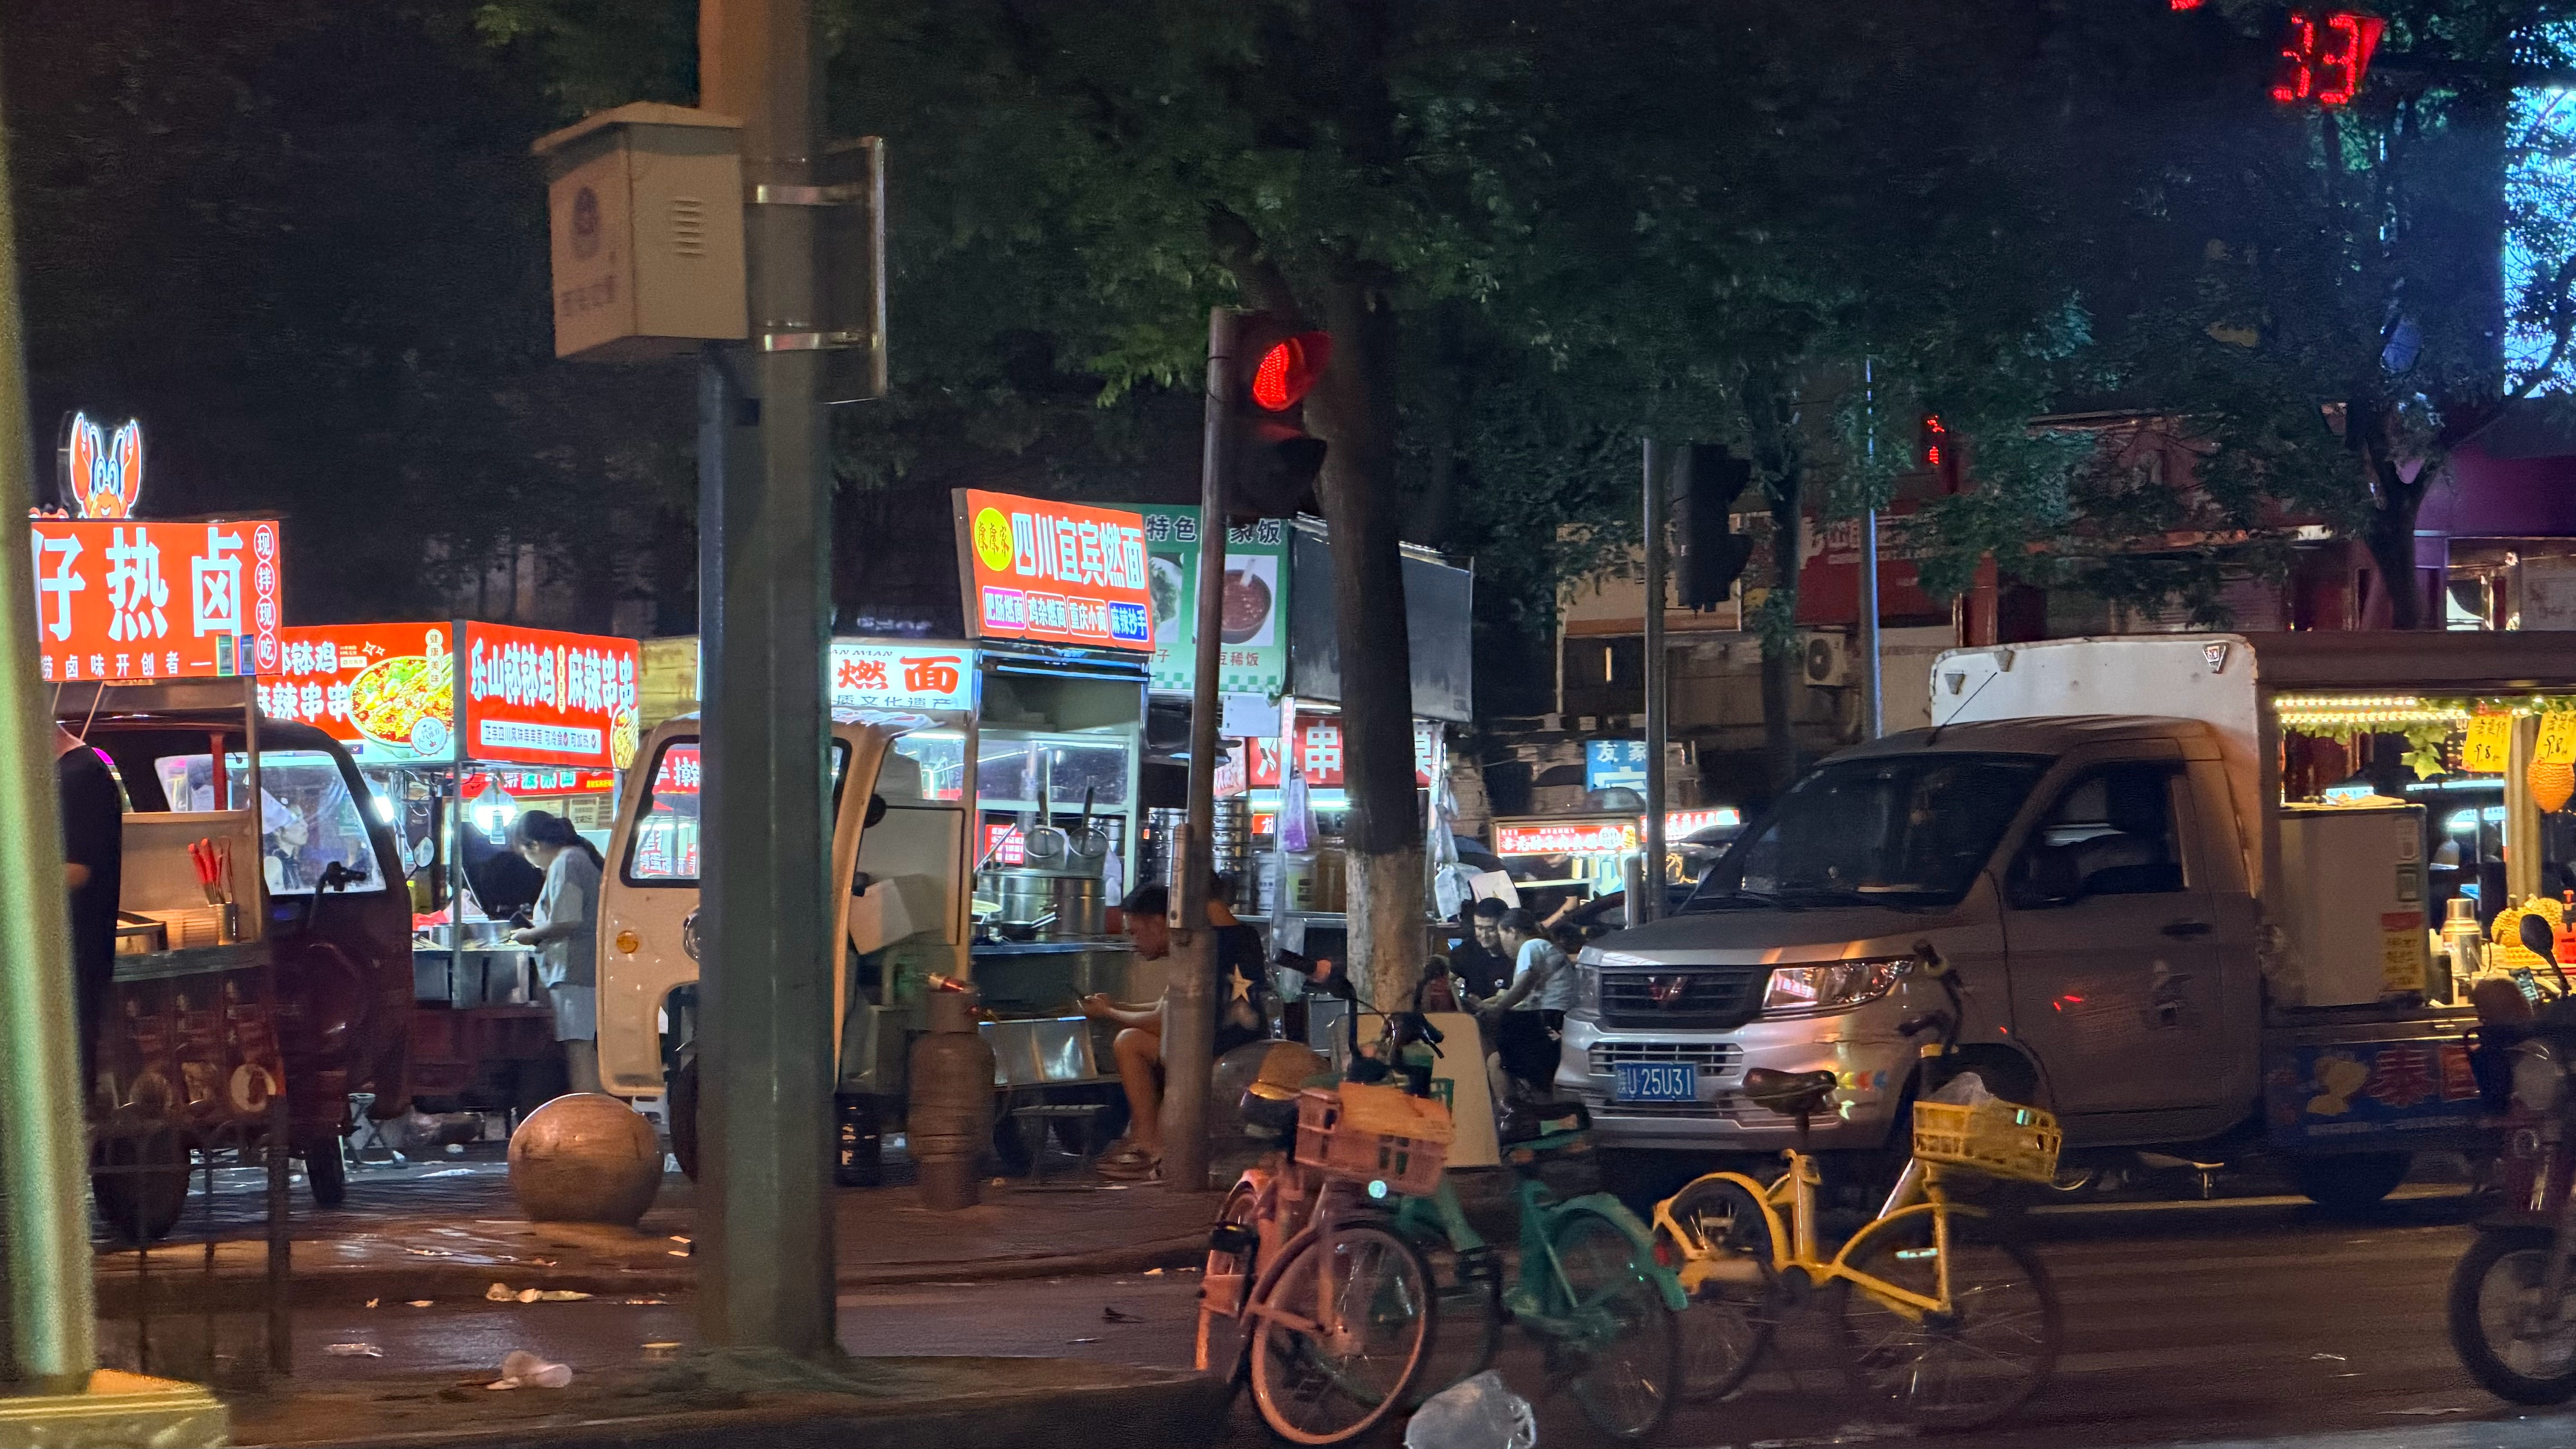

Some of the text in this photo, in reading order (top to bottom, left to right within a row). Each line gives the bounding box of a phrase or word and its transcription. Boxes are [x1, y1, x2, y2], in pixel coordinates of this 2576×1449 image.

[1012, 512, 1145, 589] 四川宜宾燃面
[1146, 514, 1281, 545] 特色家饭
[32, 527, 244, 642] 仔热卤
[257, 531, 276, 660] 现拌现吃
[985, 592, 1146, 637] 肥肠燃面 鸡杂燃面 重庆小面 麻辣抄手
[471, 637, 555, 707] 乐山钵钵鸡
[568, 647, 634, 718] 麻辣串串
[837, 655, 962, 694] 燃面
[1220, 652, 1259, 666] 豆稀饭
[833, 695, 952, 708] 质文化遗产
